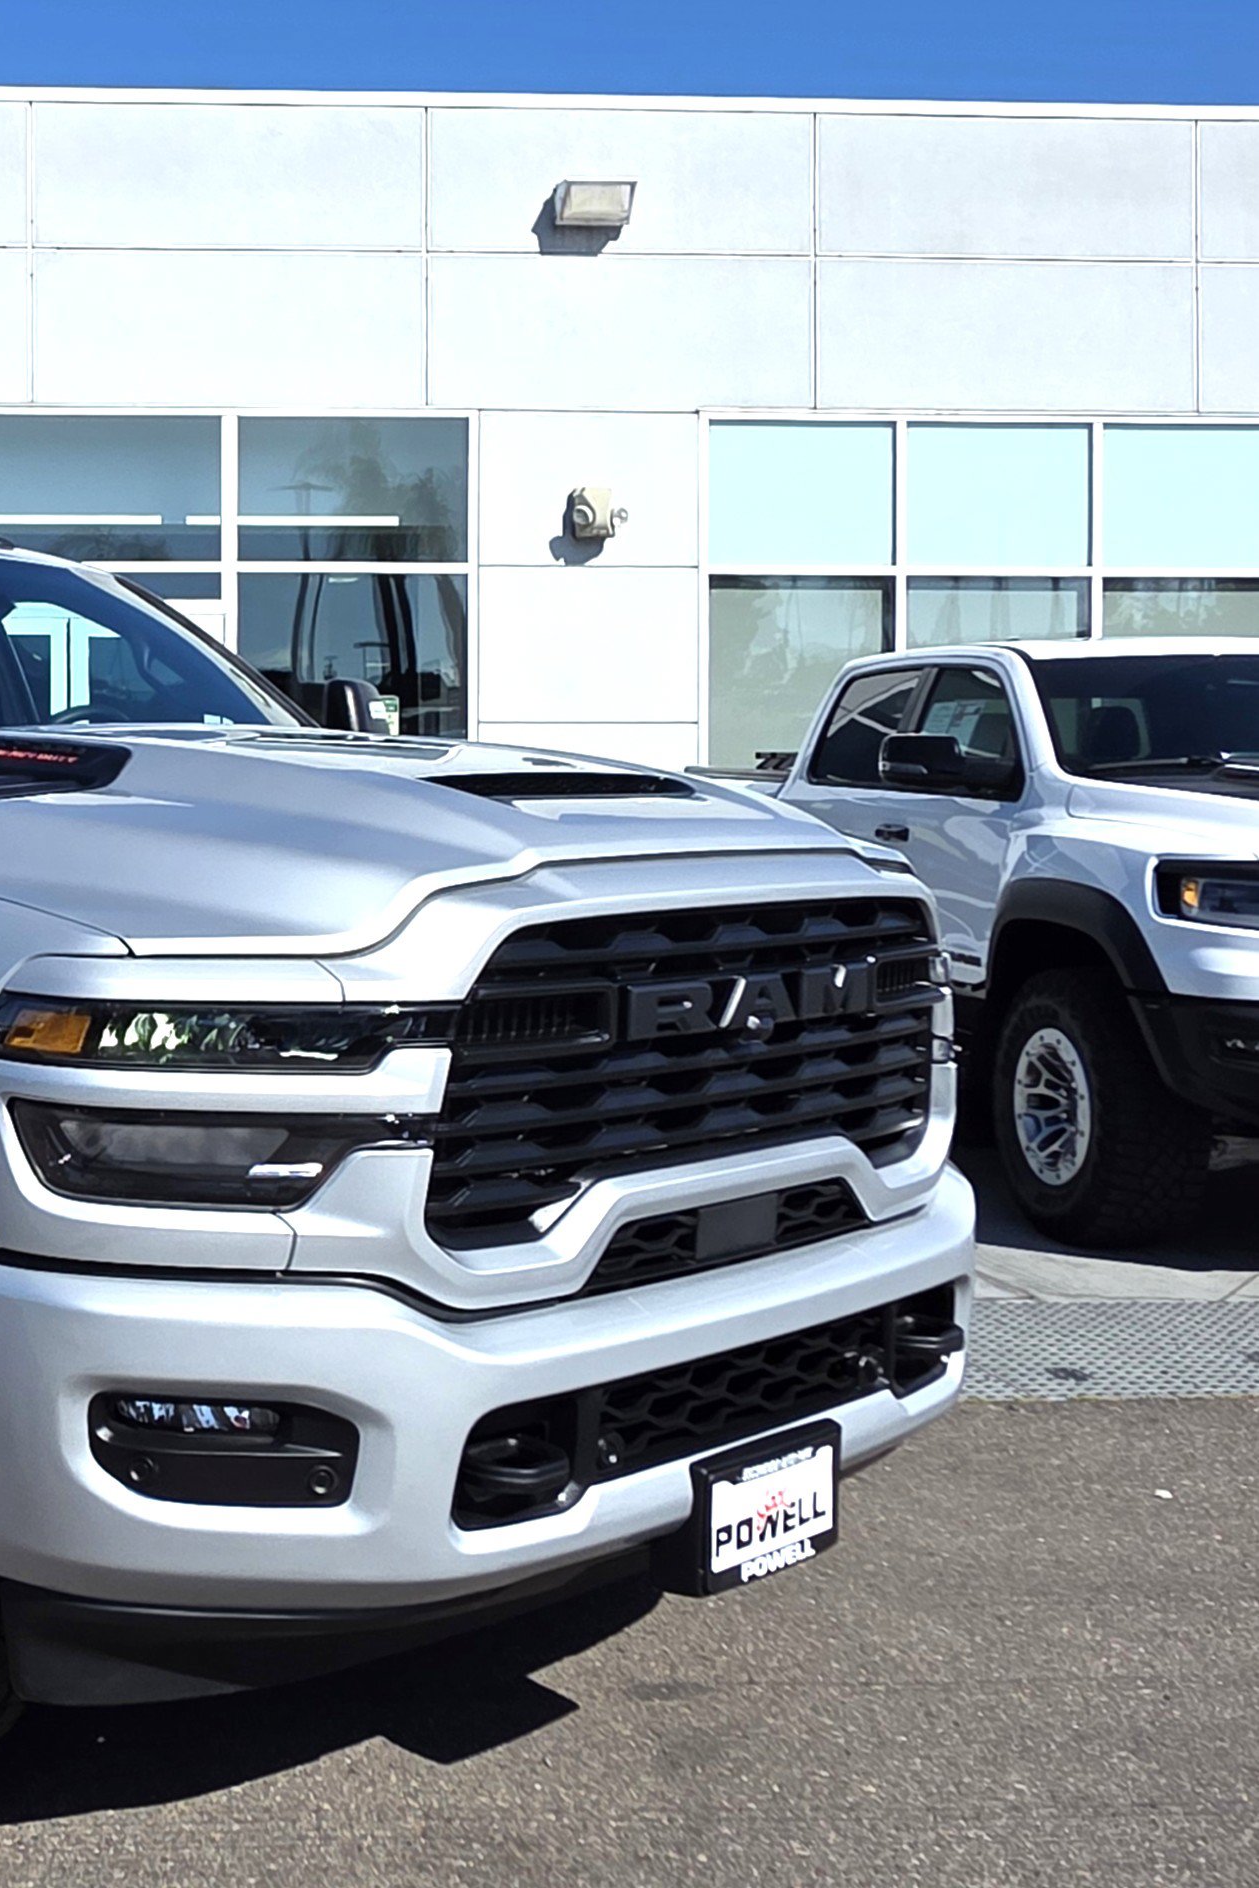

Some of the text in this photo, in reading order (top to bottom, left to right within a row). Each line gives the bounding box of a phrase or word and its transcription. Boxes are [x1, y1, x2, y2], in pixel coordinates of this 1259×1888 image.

[626, 962, 869, 1041] RAM
[715, 1491, 826, 1558] POWELL
[741, 1539, 816, 1582] POWELL
